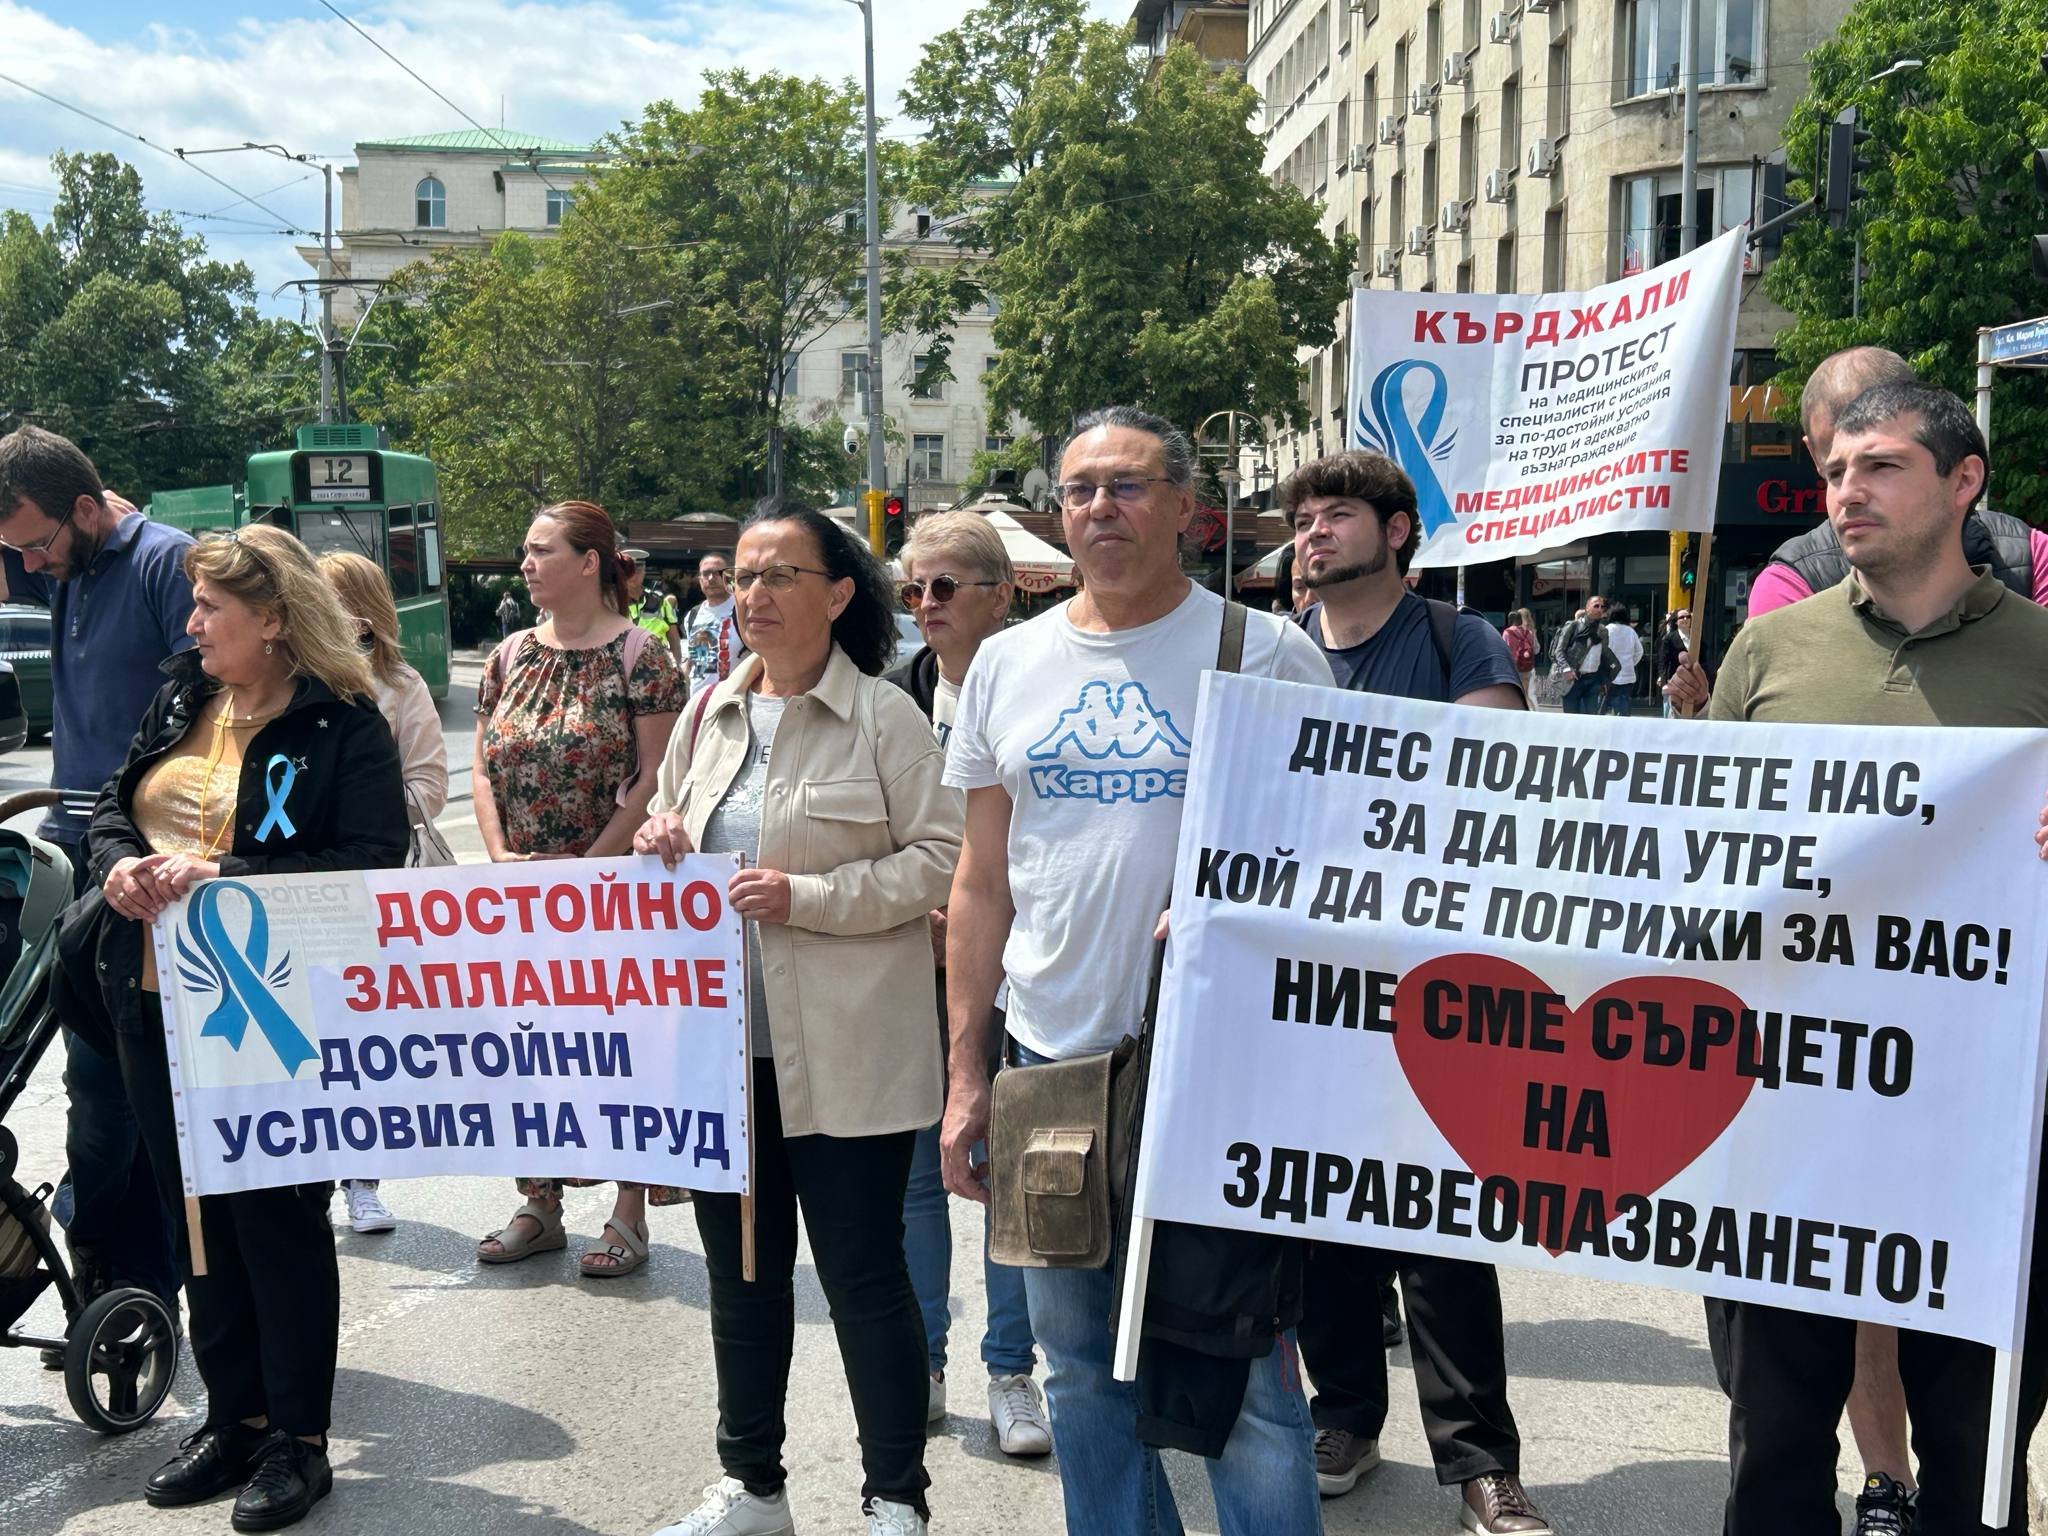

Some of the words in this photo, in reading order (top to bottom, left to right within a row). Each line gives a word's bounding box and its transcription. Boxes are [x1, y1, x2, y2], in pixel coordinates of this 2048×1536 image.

[1414, 269, 1692, 350] КЪРДЖАЛИ
[1520, 321, 1678, 392] ПРОТЕСТ
[1529, 397, 1548, 409] на
[1556, 361, 1659, 407] медицинските
[1495, 433, 1515, 445] за
[1520, 412, 1614, 444] по-достойни
[1618, 386, 1671, 423] условия
[1499, 398, 1606, 428] специалисти
[1608, 395, 1618, 406] с
[1619, 369, 1671, 402] искания
[1508, 449, 1529, 462] на
[1532, 442, 1567, 461] труд
[1570, 437, 1582, 449] и
[1583, 409, 1650, 447] адекватно
[1521, 431, 1638, 477] възнаграждение
[324, 459, 353, 484] 12
[1455, 449, 1689, 513] МЕДИЦИНСКИТЕ
[1465, 485, 1671, 545] СПЕЦИАЛИСТИ
[1029, 764, 1188, 804] Kappa
[1289, 717, 1433, 783] ДНЕС
[1446, 738, 1793, 812] ПОДКРЕПЕТЕ
[1808, 760, 1936, 826] НАС,
[1363, 798, 1427, 854] ЗА
[1442, 809, 1518, 868] ДА
[1536, 818, 1660, 881] ИМА
[1684, 829, 1832, 899] УТРЕ,
[376, 872, 722, 947] ДОСТОЙНО
[1195, 846, 1301, 910] КОЙ
[1308, 865, 1383, 924] ДА
[1402, 877, 1472, 932] СЕ
[1483, 886, 1763, 962] ПОГРИЖИ
[1782, 913, 1856, 967] ЗА
[1874, 914, 2012, 985] ВАС!
[343, 957, 728, 1016] ЗАПЛАЩАНЕ
[319, 1021, 633, 1091] ДОСТОЙНИ
[1272, 957, 1399, 1035] НИЕ
[1423, 978, 1567, 1054] СМЕ
[1591, 997, 1914, 1098] СЪРЦЕТО
[213, 1102, 496, 1163] УСЛОВИЯ
[511, 1101, 588, 1150] НА
[599, 1103, 731, 1171] ТРУД
[1522, 1081, 1612, 1159] НА
[1223, 1141, 1950, 1310] ЗДРАВЕОПАЗВАНЕТО!
